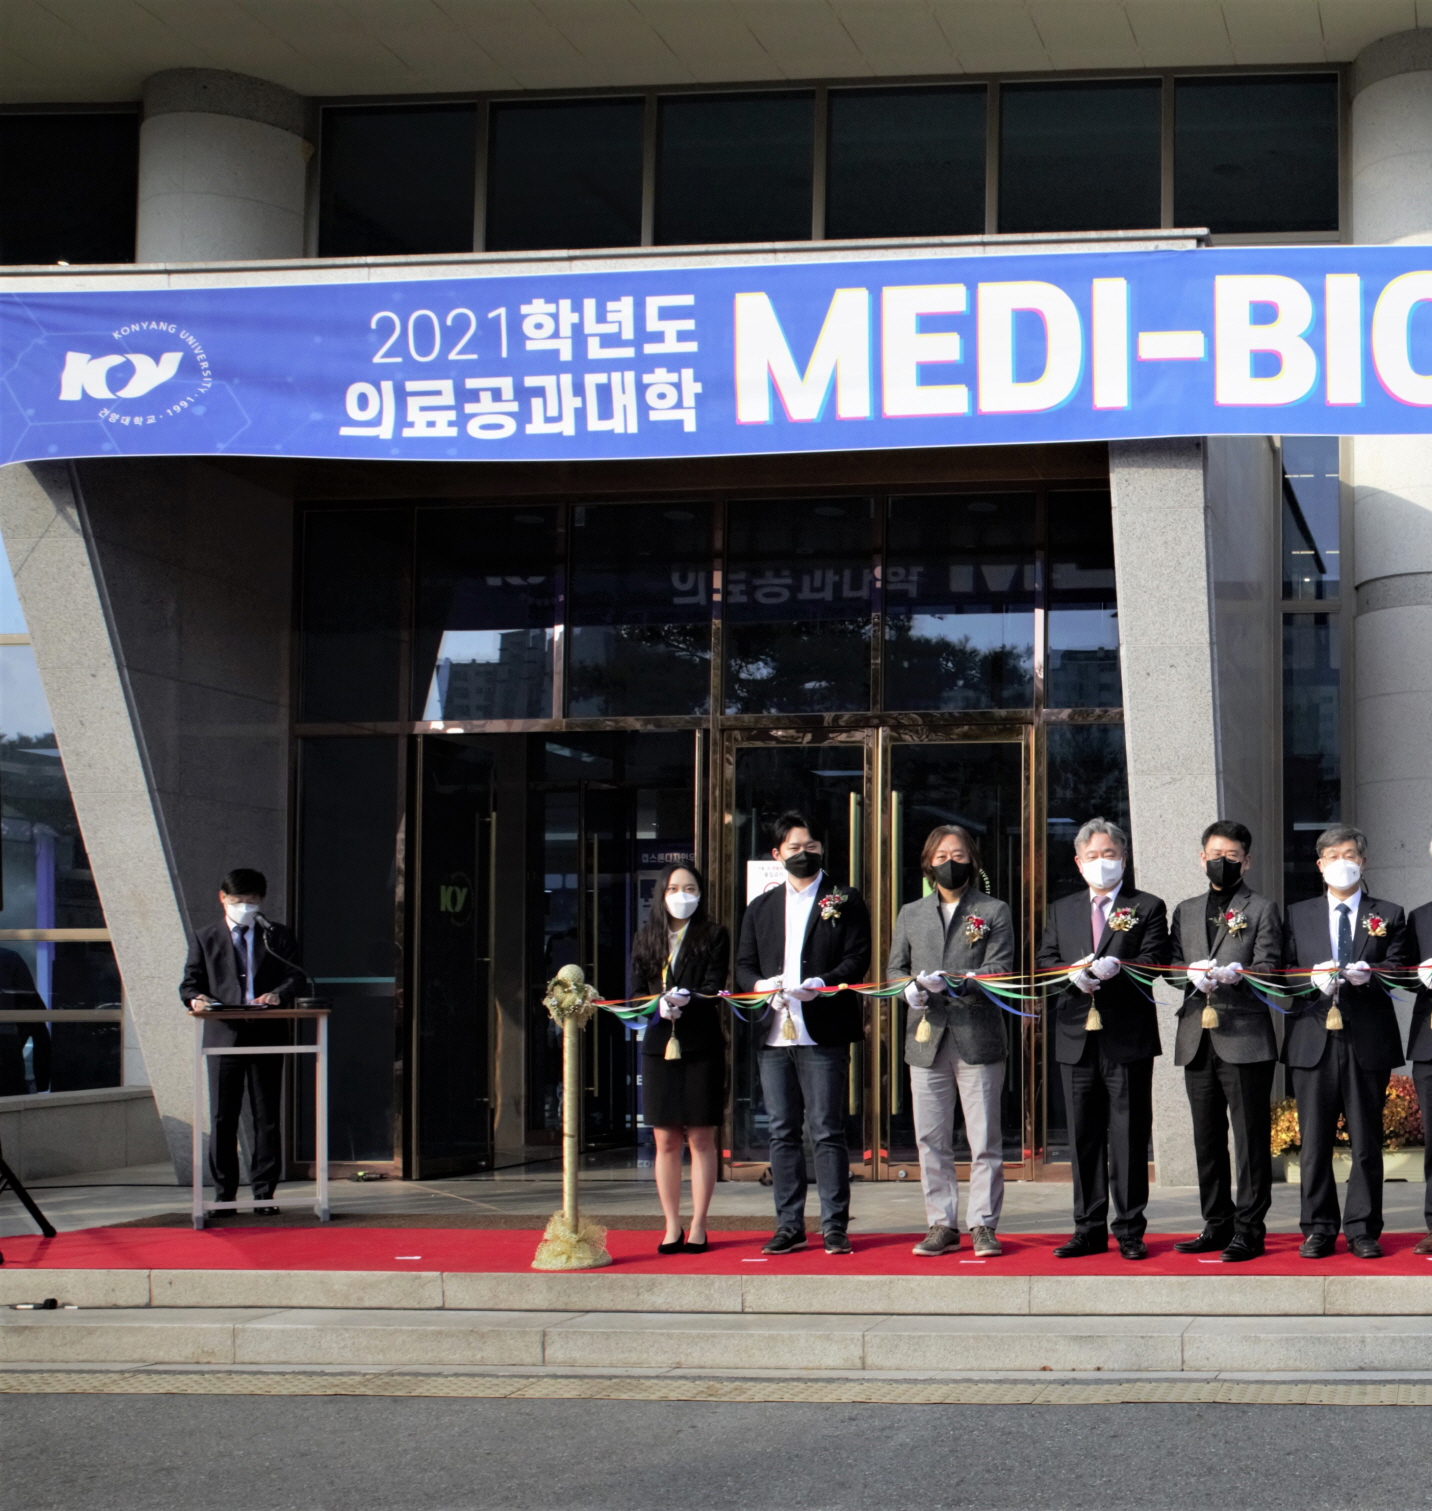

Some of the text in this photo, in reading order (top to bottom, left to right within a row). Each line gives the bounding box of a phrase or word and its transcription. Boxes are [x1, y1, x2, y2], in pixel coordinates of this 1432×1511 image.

[112, 321, 213, 394] KONYANG UNIVERSITY
[370, 294, 699, 364] 2021학년도
[98, 407, 157, 426] 건양대학교
[338, 367, 703, 440] 의료공과대학
